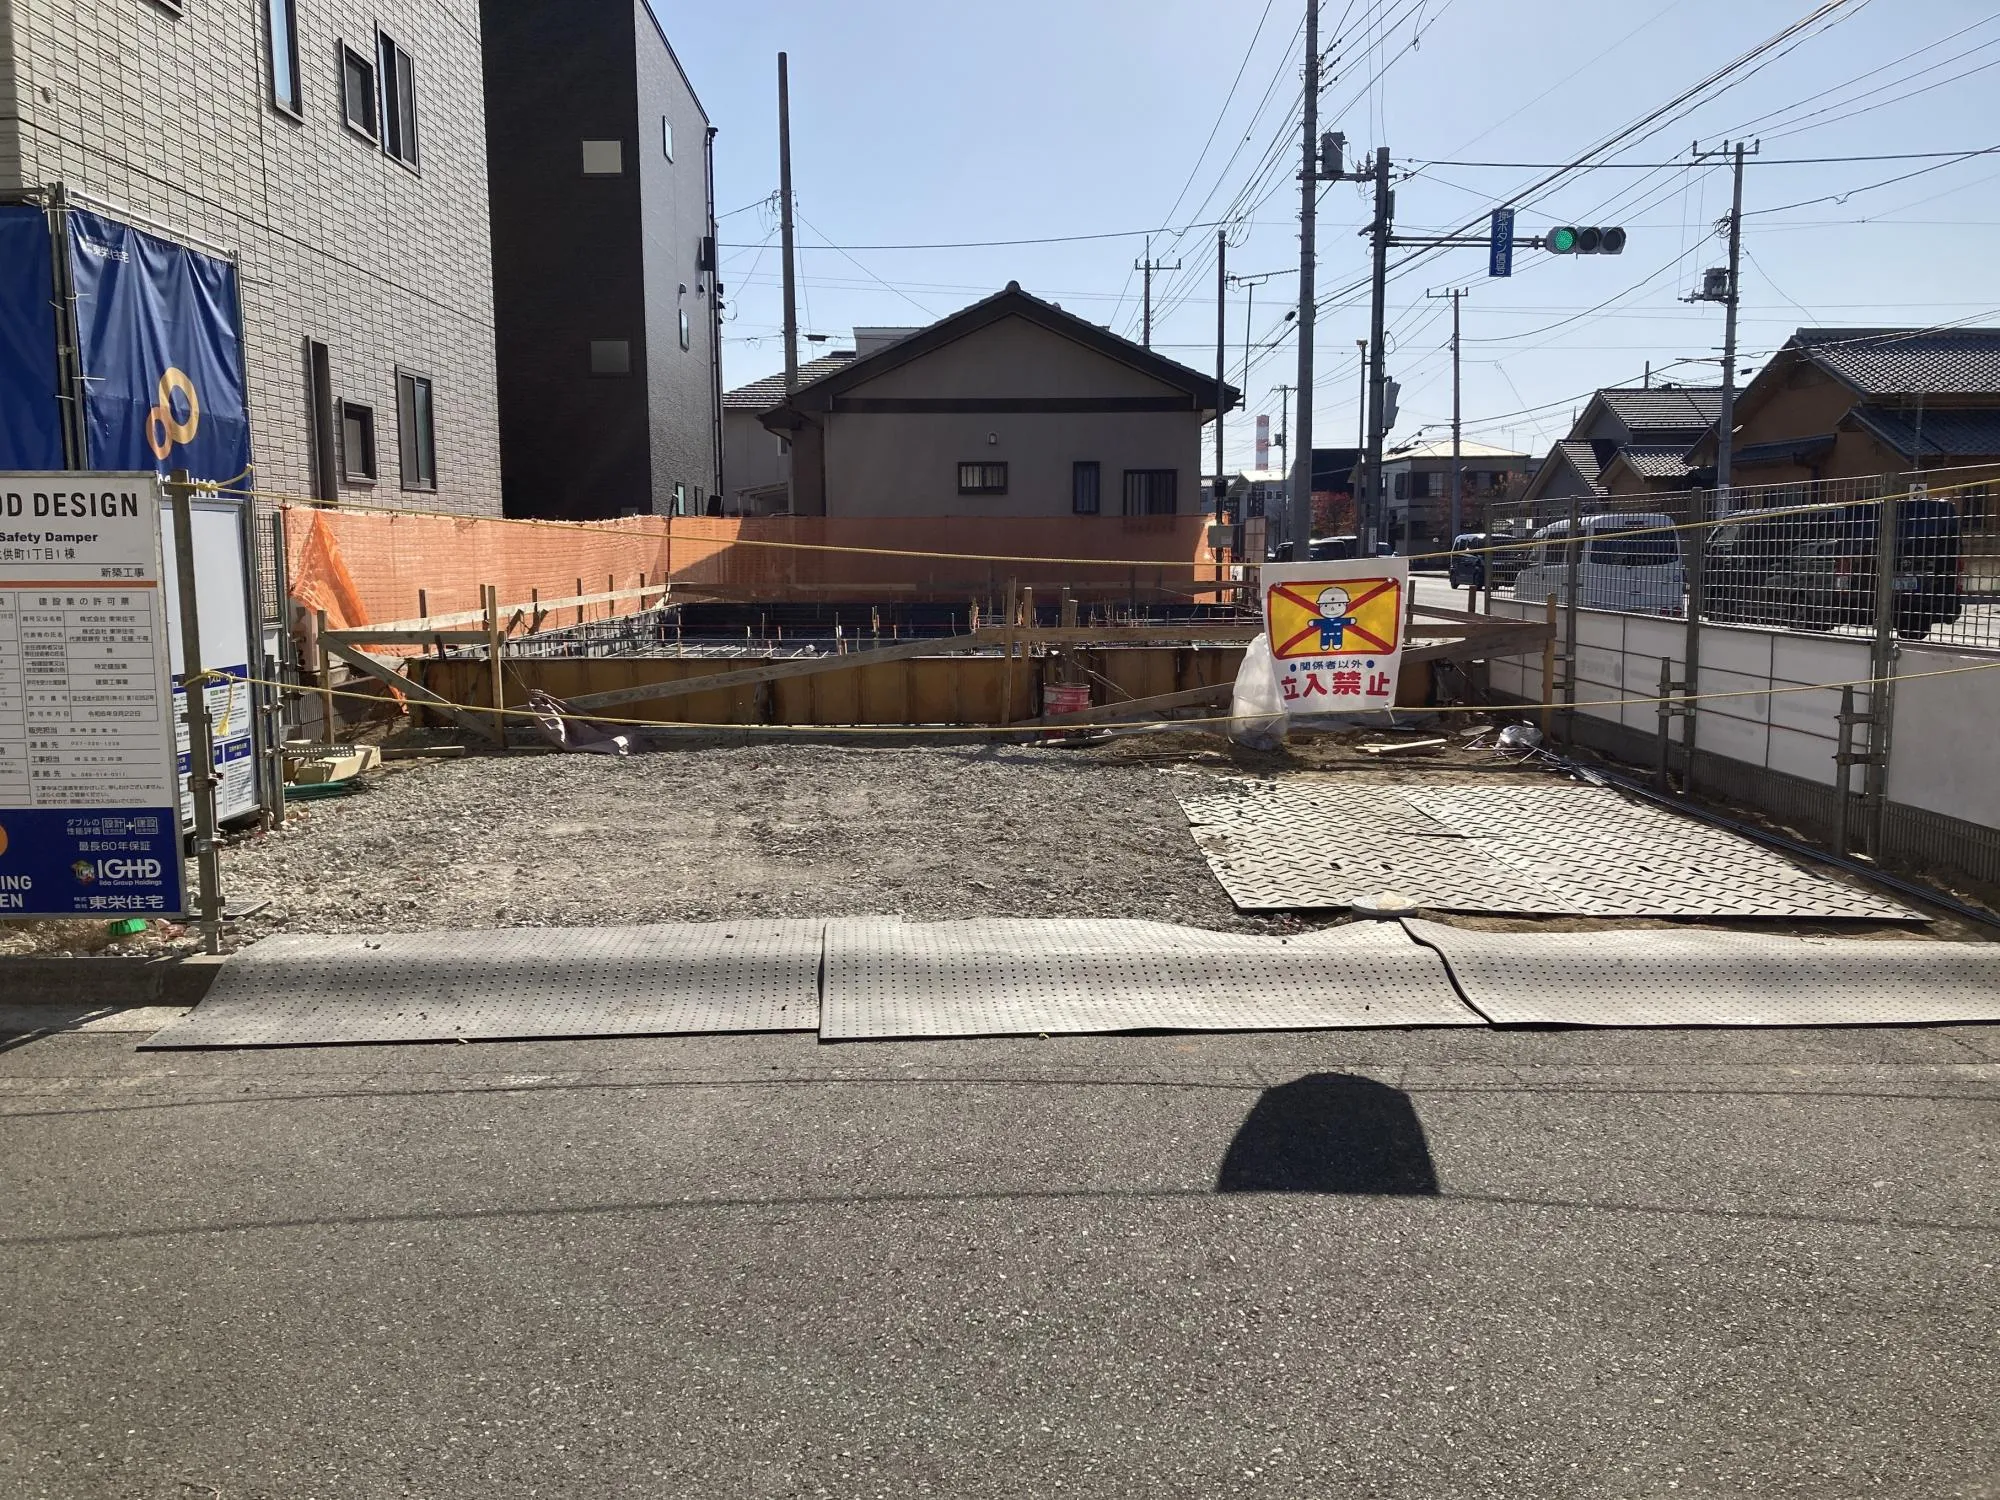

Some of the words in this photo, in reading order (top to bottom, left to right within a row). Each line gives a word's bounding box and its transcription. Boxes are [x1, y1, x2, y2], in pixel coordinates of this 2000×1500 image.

[33, 492, 138, 517] DESIGN
[0, 532, 41, 544] Safety
[45, 531, 99, 545] Damper
[101, 567, 145, 578] 新築工事
[1300, 659, 1363, 672] 関係者以外
[1280, 670, 1391, 701] 立入禁止
[66, 818, 100, 827] ダブルの
[104, 819, 124, 829] 設計
[79, 841, 151, 852] 最長60年保証
[97, 859, 162, 880] IGHD
[89, 895, 165, 910] 東栄住宅
